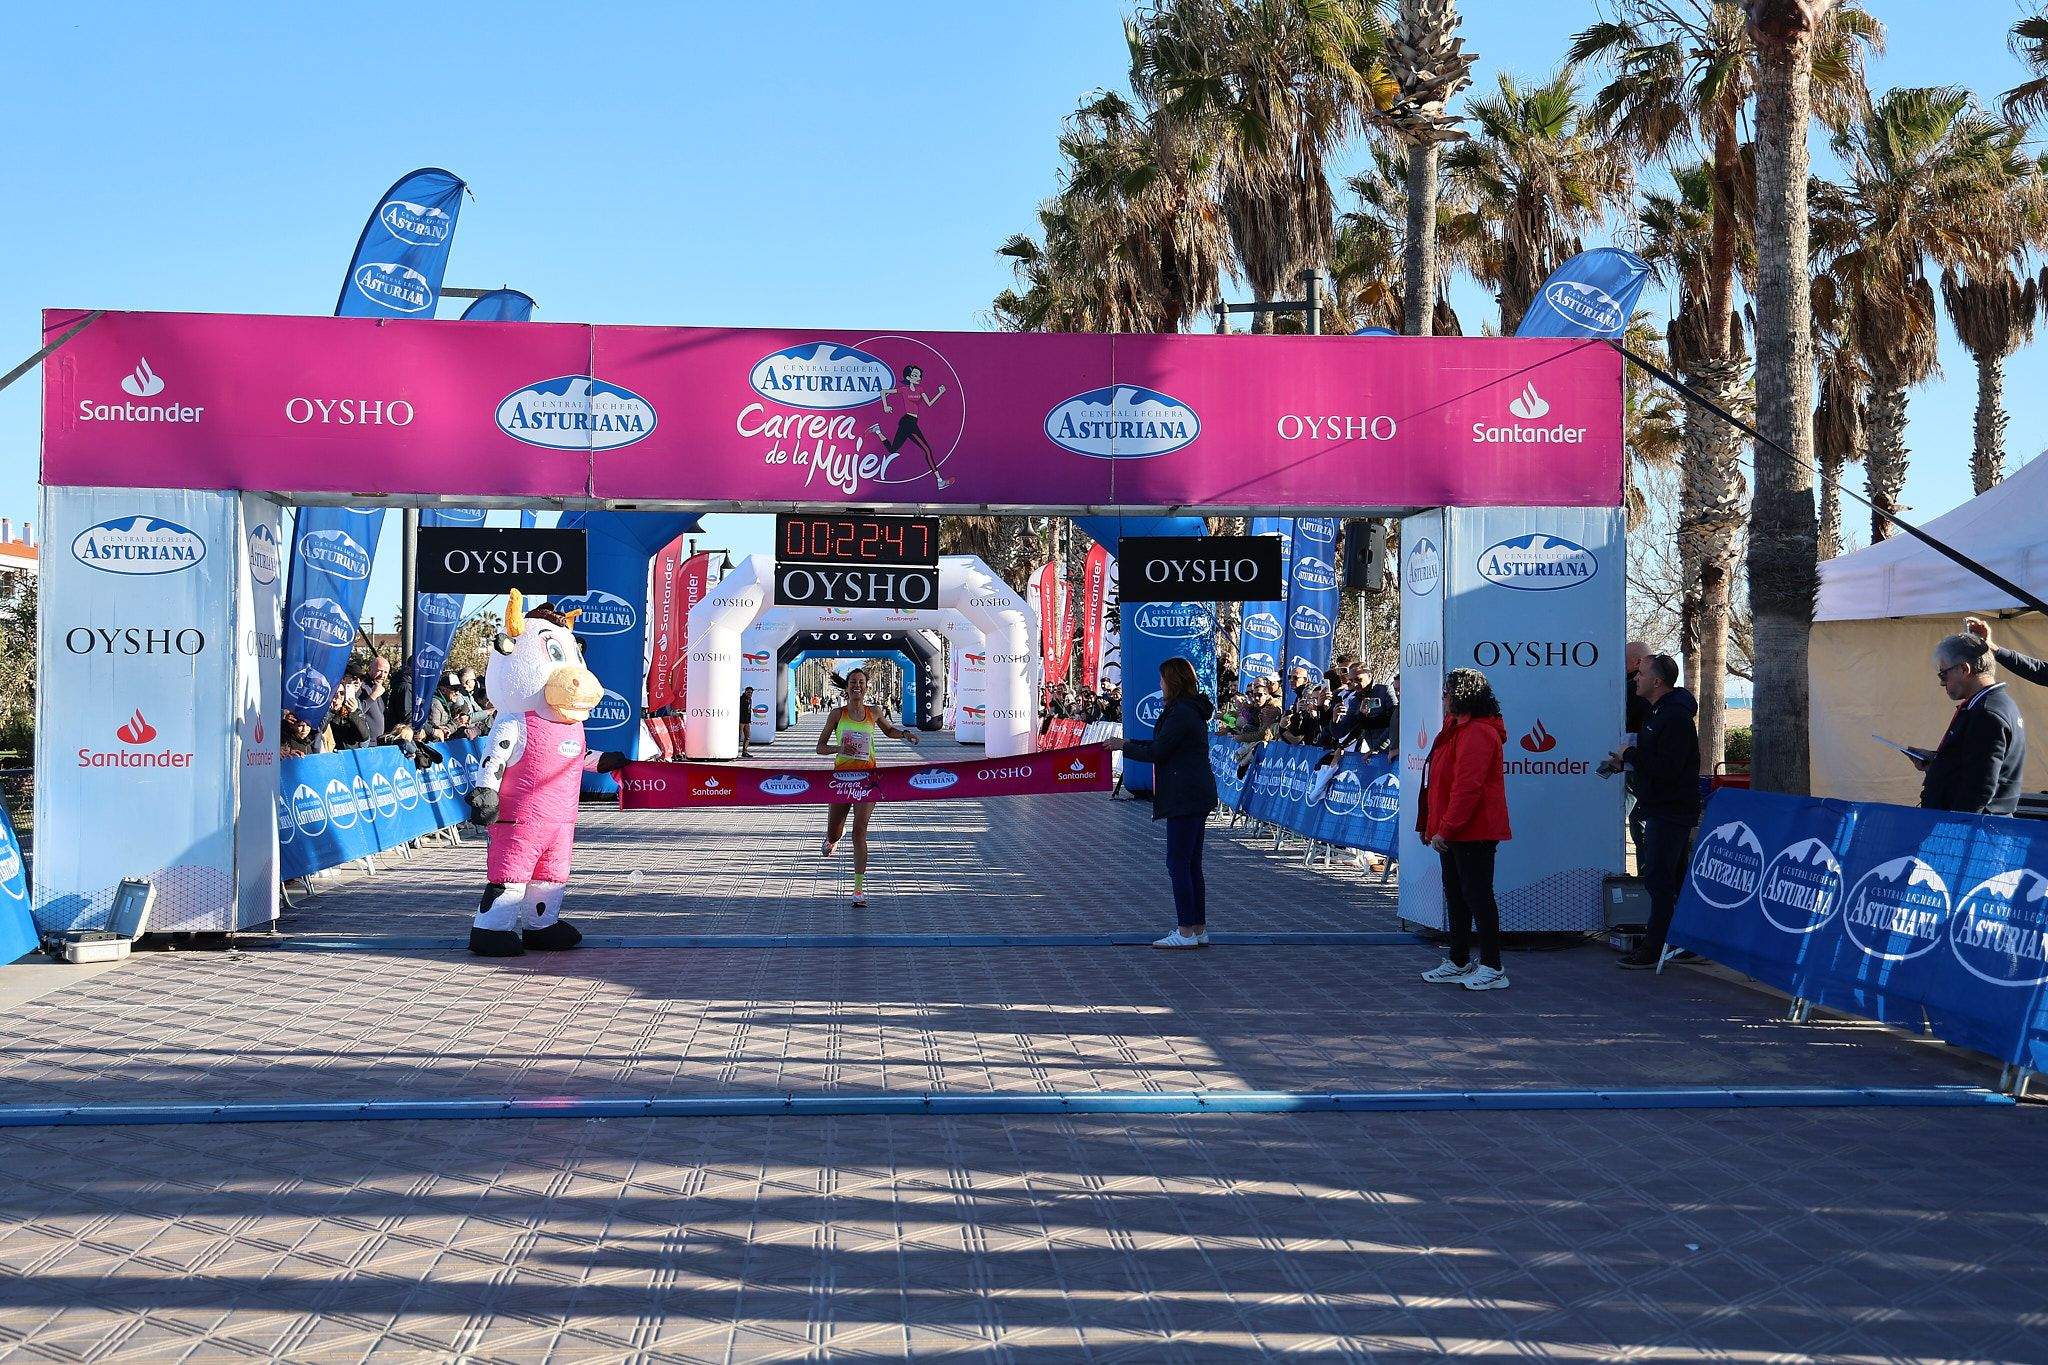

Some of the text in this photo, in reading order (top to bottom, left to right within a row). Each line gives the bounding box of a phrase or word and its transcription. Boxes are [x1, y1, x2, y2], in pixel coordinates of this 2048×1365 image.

[1549, 286, 1617, 328] ASTURIANA
[761, 366, 883, 392] ASTURIANA
[784, 364, 880, 373] CENTRAL LECHERA
[79, 400, 204, 424] Santander
[286, 397, 415, 426] OYSHO
[508, 402, 645, 432] ASTURIANA
[588, 402, 640, 411] LECHERA
[736, 403, 856, 440] Carrera
[1057, 411, 1189, 439] ASTURIANA
[1277, 415, 1397, 441] OYSHO
[1472, 422, 1587, 444] Santander
[765, 437, 900, 494] de la Mujer
[82, 537, 196, 561] ASTURIANA
[787, 521, 928, 557] 00:22:47
[444, 550, 563, 575] OYSHO
[1145, 558, 1259, 583] OYSHO
[1486, 554, 1589, 577] ASTURIANA
[660, 556, 675, 632] Santander
[783, 570, 931, 604] OYSHO
[1089, 559, 1102, 634] Santander
[713, 598, 754, 608] OYSHO
[970, 598, 1011, 608] OYSHO
[66, 627, 205, 656] OYSHO
[811, 633, 892, 641] VOLVO
[992, 654, 1031, 664] OYSHO
[1406, 641, 1439, 668] OYSHO
[1474, 641, 1599, 667] OYSHO
[992, 709, 1031, 719] OYSHO
[78, 749, 193, 768] Santander
[1503, 757, 1589, 775] antander
[624, 779, 666, 791] YSHO
[913, 777, 955, 785] ASTURIANA
[977, 766, 1032, 781] OYSHO
[1057, 771, 1096, 780] Santander
[692, 787, 731, 796] Santander
[1695, 844, 1756, 893] ASTURIANA
[1782, 865, 1807, 880] CENTRAL
[1763, 866, 1833, 916] ASTURIANA
[1870, 886, 1941, 908] CENTRAL LECHERA
[1848, 886, 1938, 940] ASTURIANA
[1982, 902, 2021, 920] CENTRAL
[1954, 902, 2048, 962] ASTURIAN
